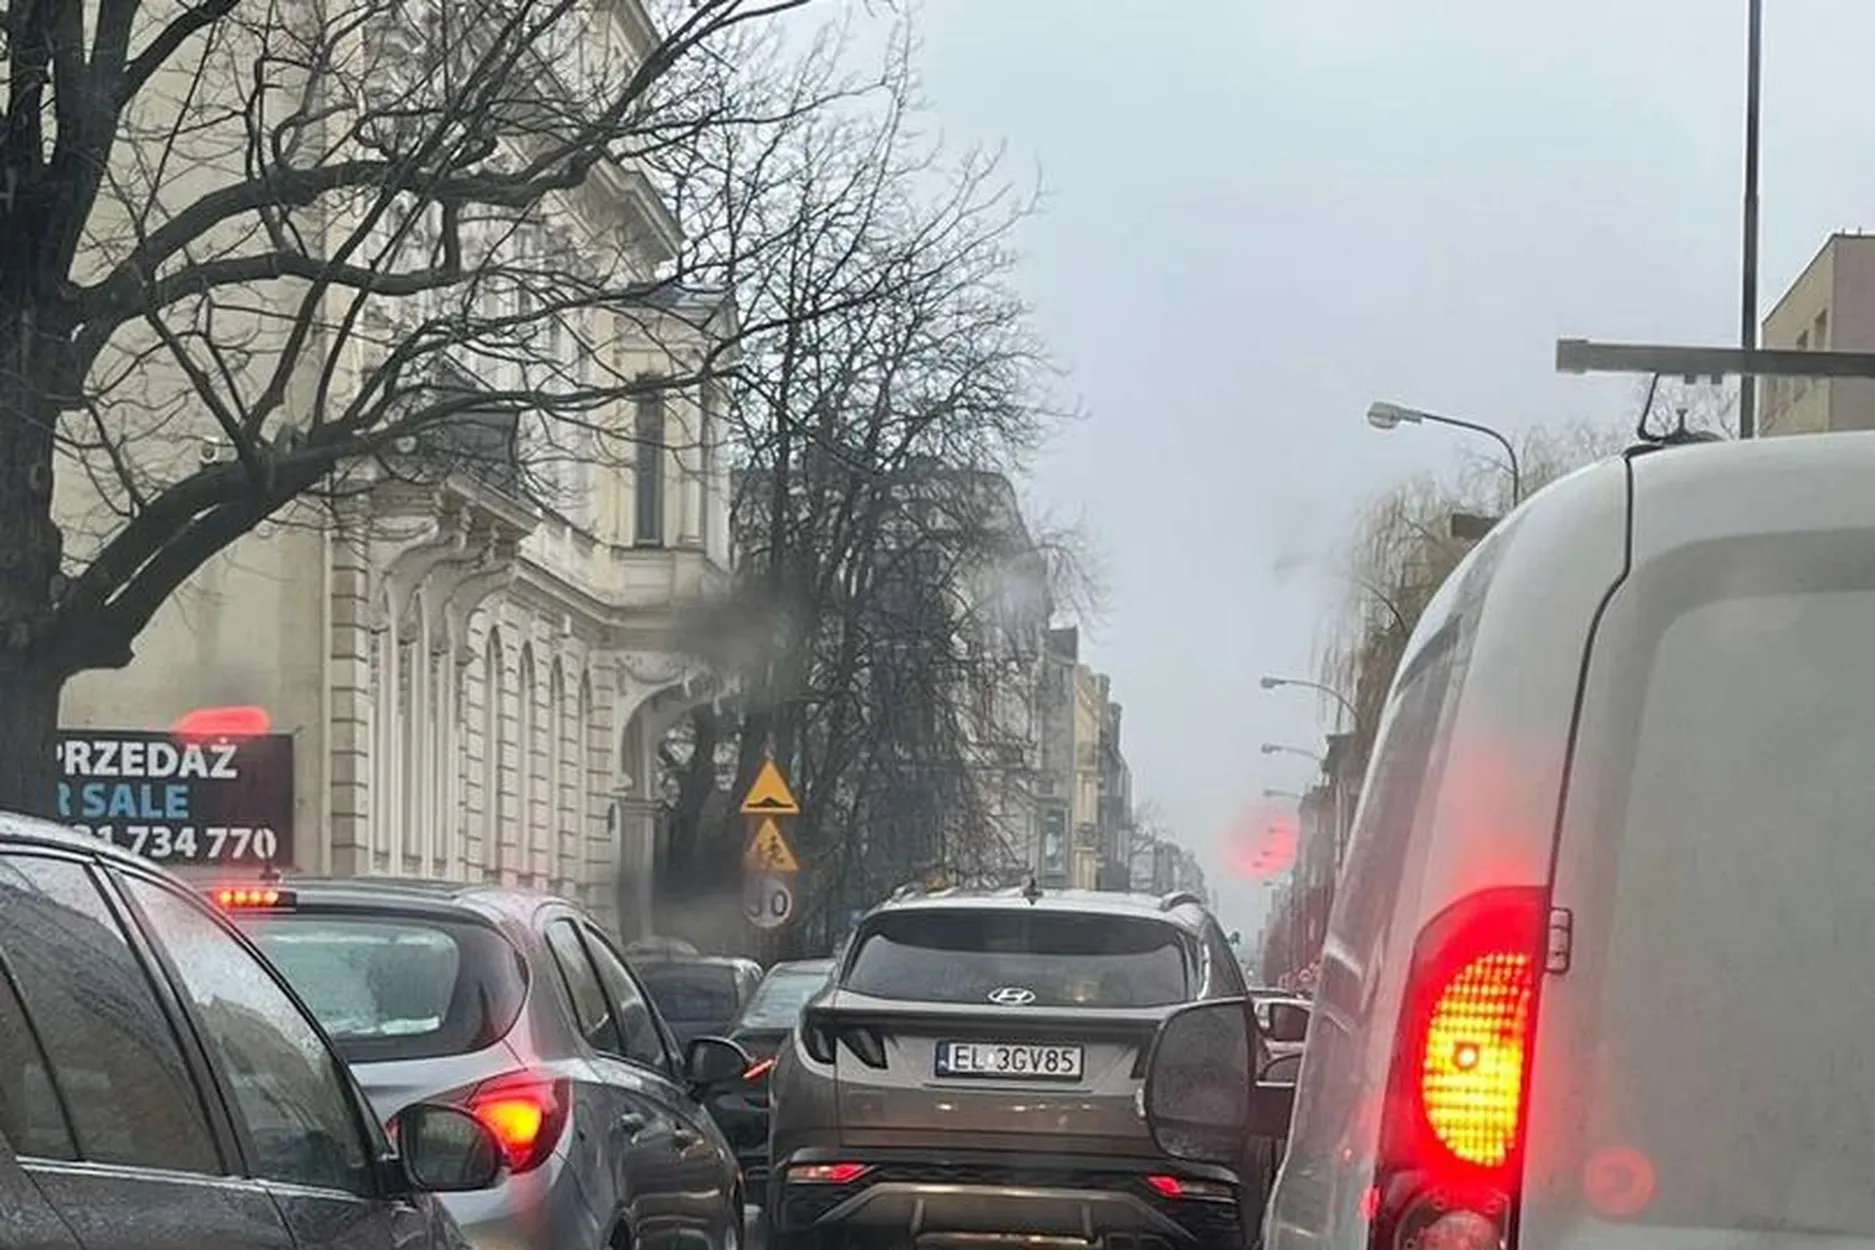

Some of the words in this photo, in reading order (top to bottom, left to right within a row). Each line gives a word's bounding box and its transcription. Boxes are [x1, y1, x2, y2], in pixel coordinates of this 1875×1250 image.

[57, 737, 239, 778] RZEDAŻ
[82, 784, 189, 819] SALE
[128, 826, 198, 858] 734
[206, 827, 277, 860] 770
[954, 1045, 985, 1070] EL
[996, 1047, 1074, 1073] 3GV85
